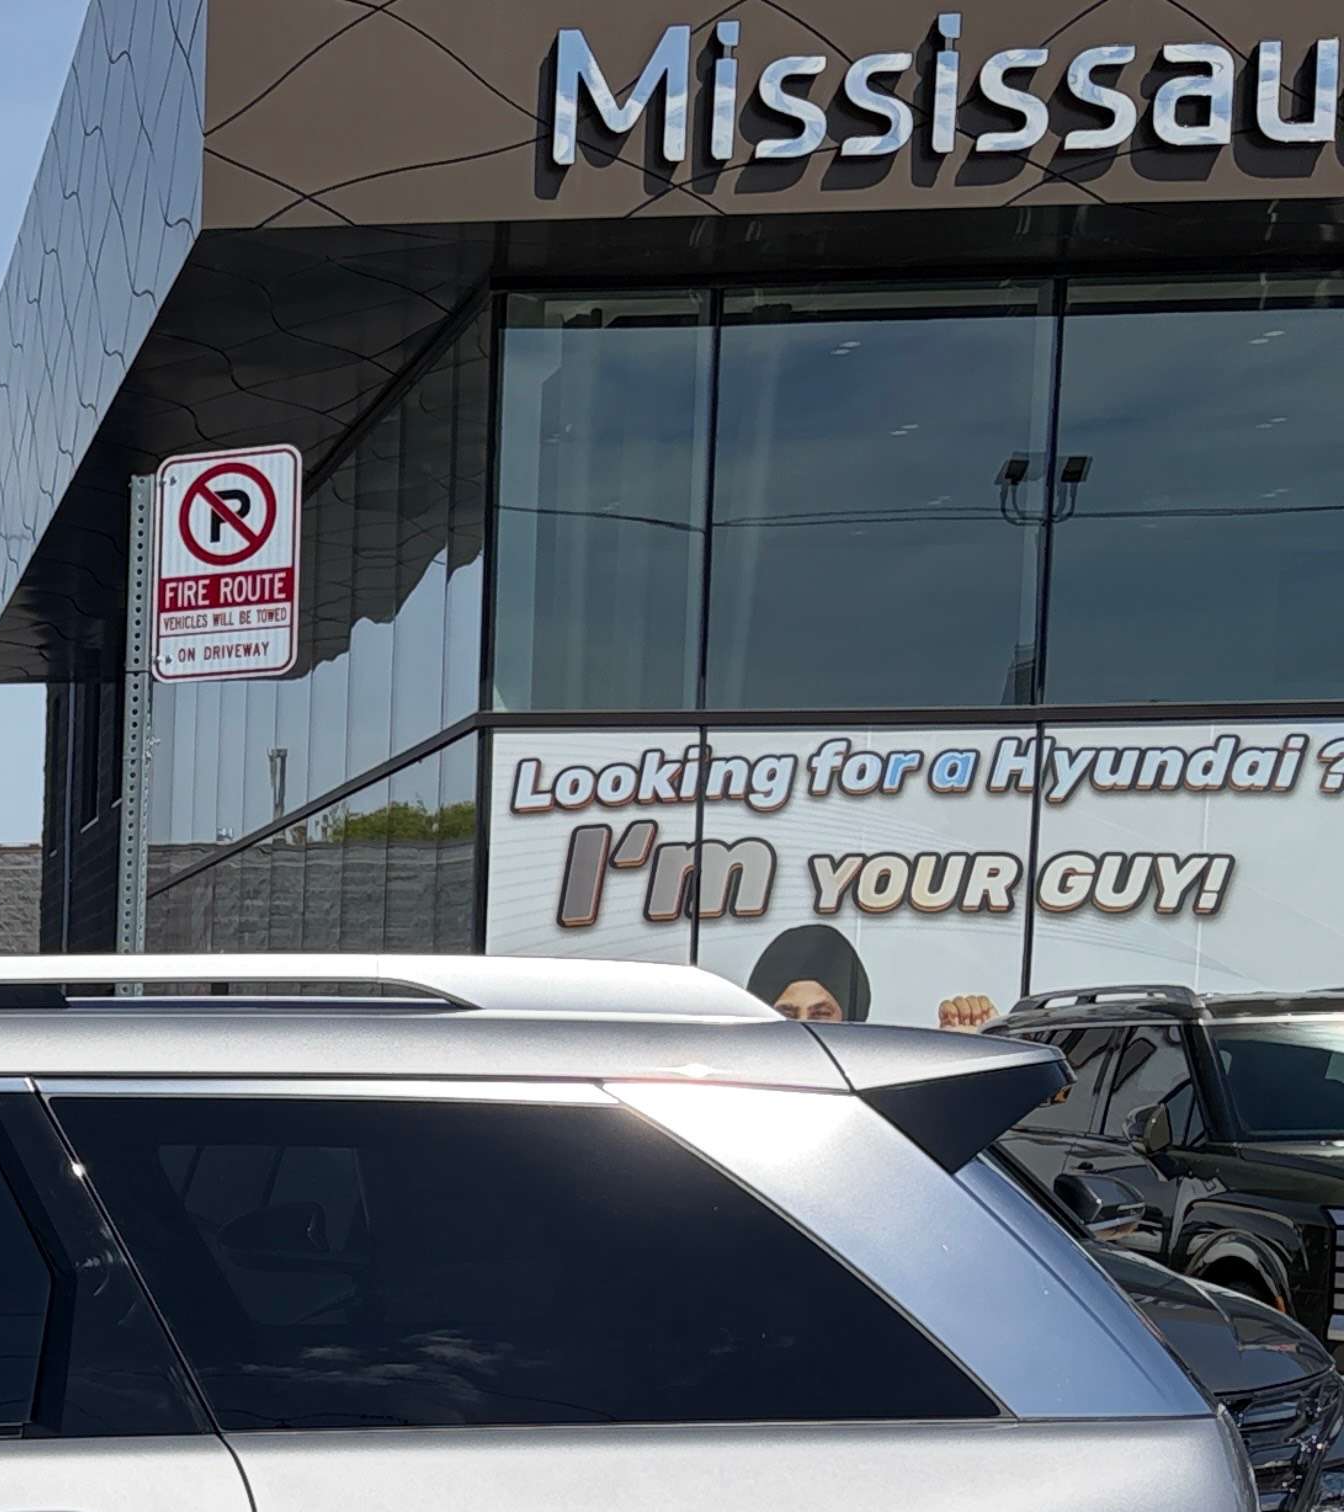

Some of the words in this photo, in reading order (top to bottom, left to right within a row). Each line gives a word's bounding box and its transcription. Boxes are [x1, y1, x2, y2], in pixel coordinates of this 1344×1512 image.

[552, 12, 1340, 166] Mississau
[164, 579, 210, 609] FIRE
[219, 571, 287, 604] ROUTE
[162, 613, 208, 632] VEHICLES
[213, 611, 235, 627] WILL
[239, 610, 252, 624] BE
[256, 607, 287, 623] TOWED
[177, 648, 196, 663] ON
[203, 641, 270, 661] DRIVEWAY
[511, 744, 798, 812] Looking
[808, 737, 924, 796] for
[928, 748, 981, 794] a
[986, 733, 1310, 803] Hyundai
[557, 819, 778, 928] I'm
[808, 851, 1024, 915] YOUR
[1037, 850, 1236, 915] GUY!
